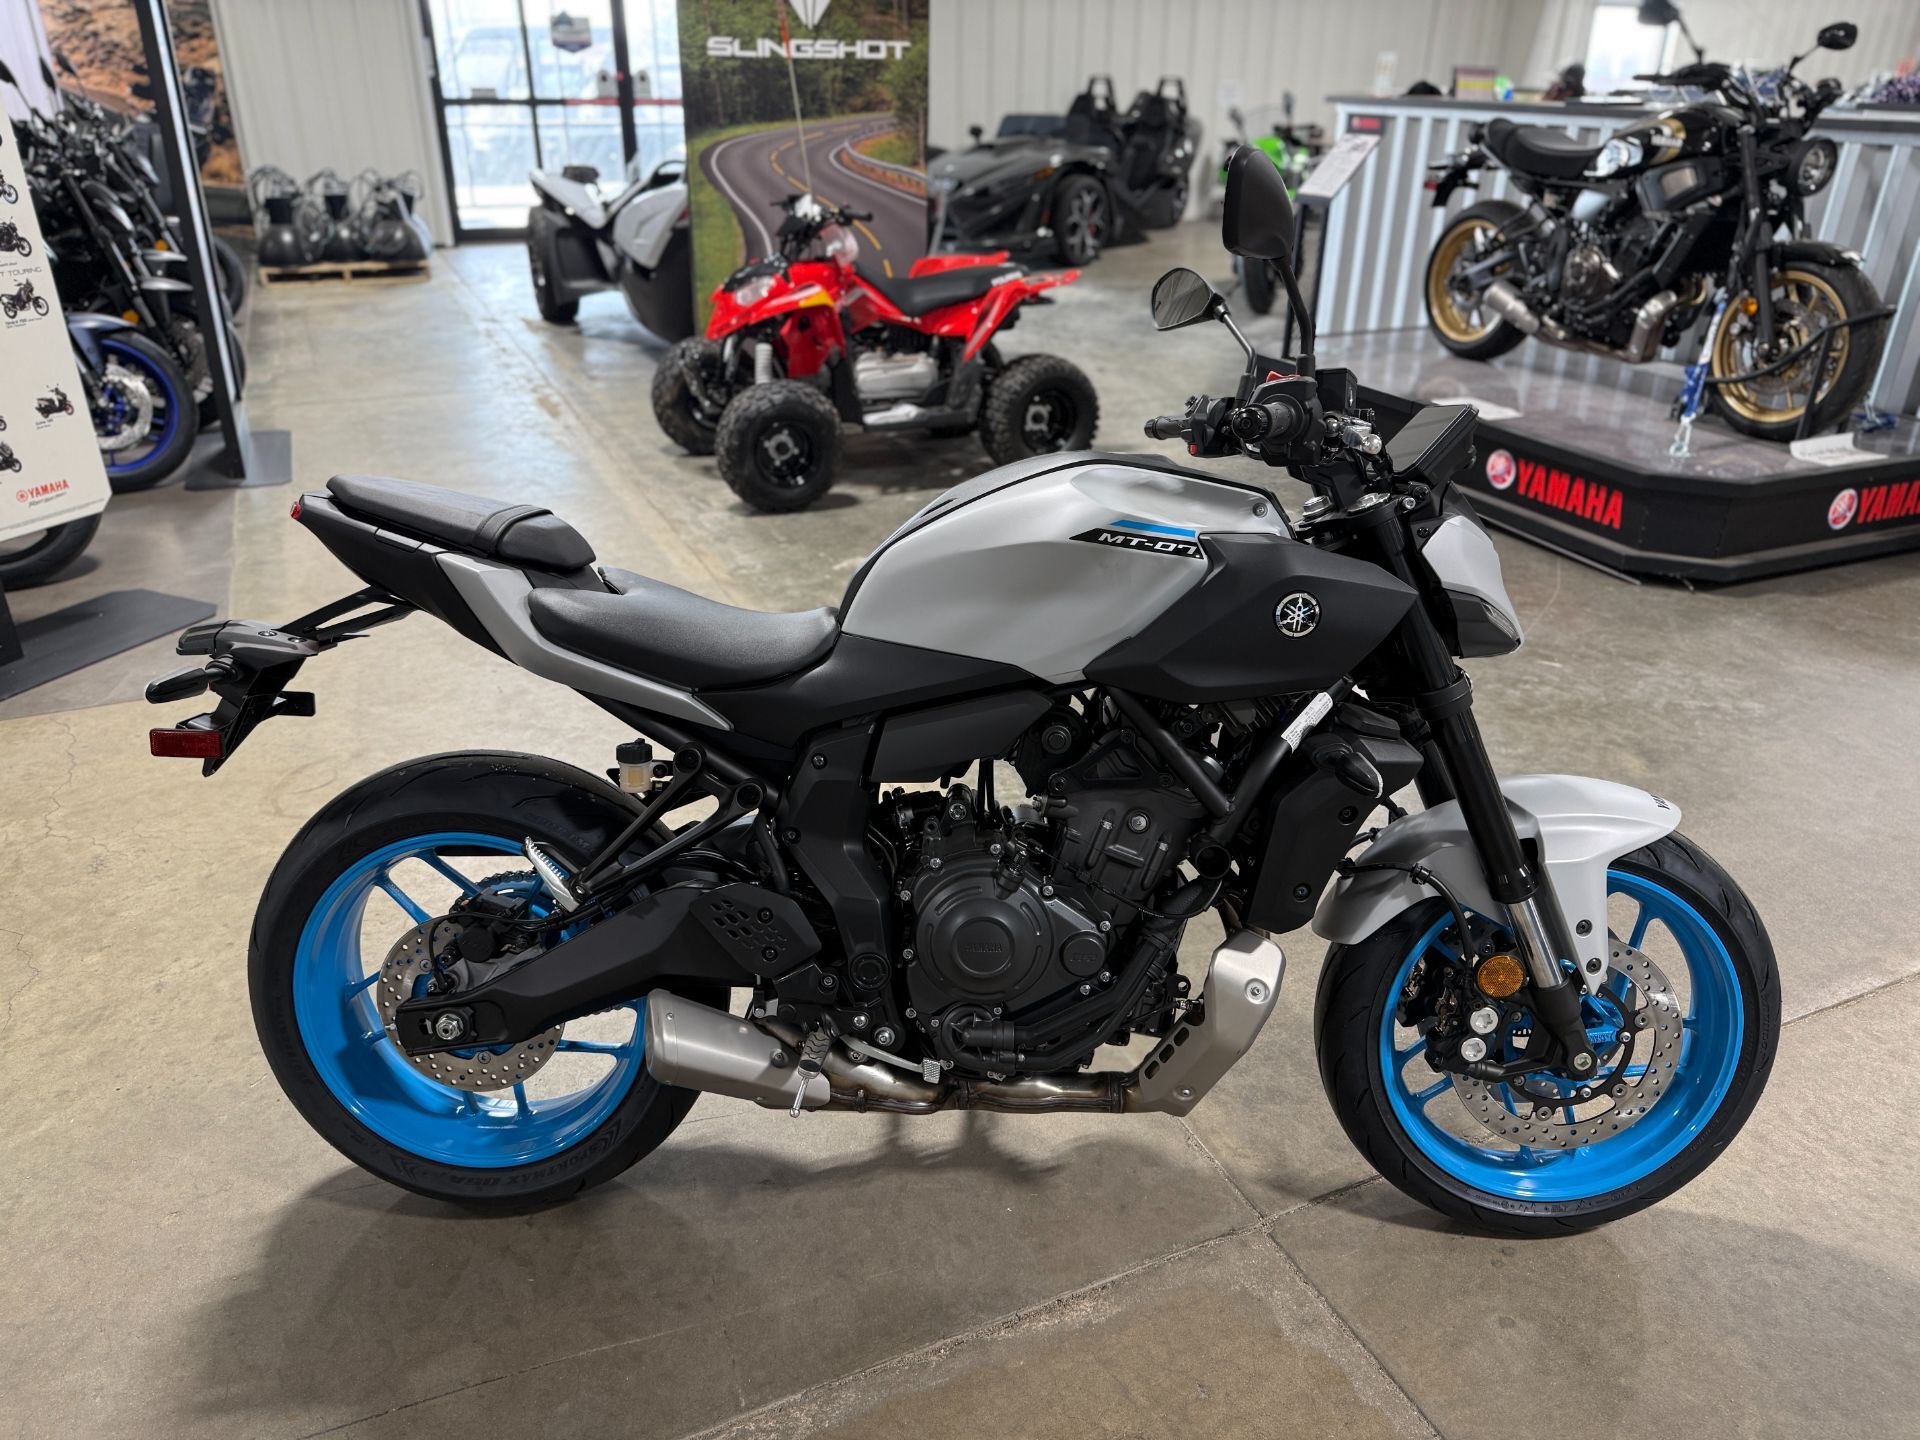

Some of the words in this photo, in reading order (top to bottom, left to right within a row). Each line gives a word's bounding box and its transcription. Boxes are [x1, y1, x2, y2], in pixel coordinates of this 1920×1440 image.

[706, 36, 911, 60] SLINGSHOT
[28, 479, 70, 499] YAMAHA
[1517, 458, 1623, 530] YAMAHA
[1857, 480, 1920, 524] YAMA
[1098, 532, 1198, 555] MT-07
